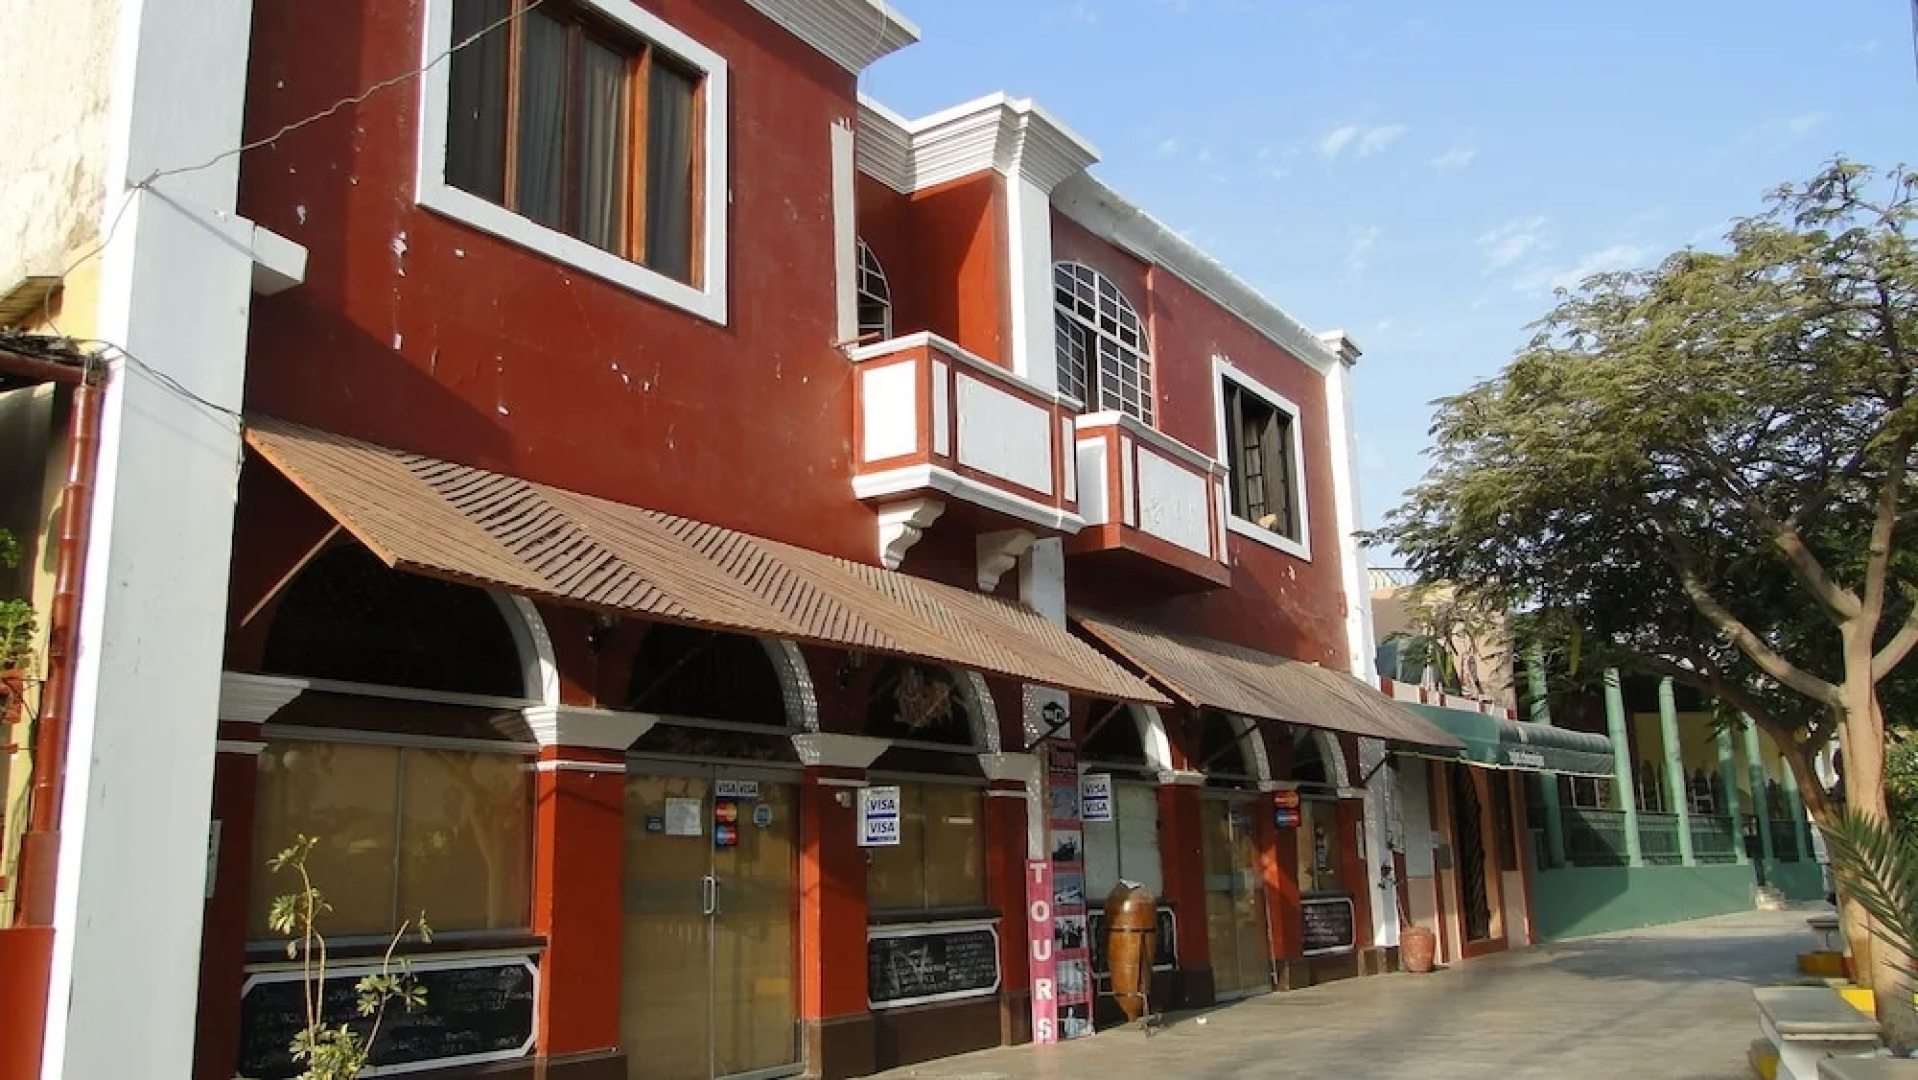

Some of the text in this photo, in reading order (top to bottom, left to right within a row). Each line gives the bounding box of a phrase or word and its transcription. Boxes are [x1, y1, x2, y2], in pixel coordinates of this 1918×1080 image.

[1085, 784, 1108, 794] VISA
[870, 799, 895, 810] VISA
[1085, 802, 1108, 812] VISA
[870, 822, 895, 833] VISA
[1029, 862, 1053, 1041] TOURS
